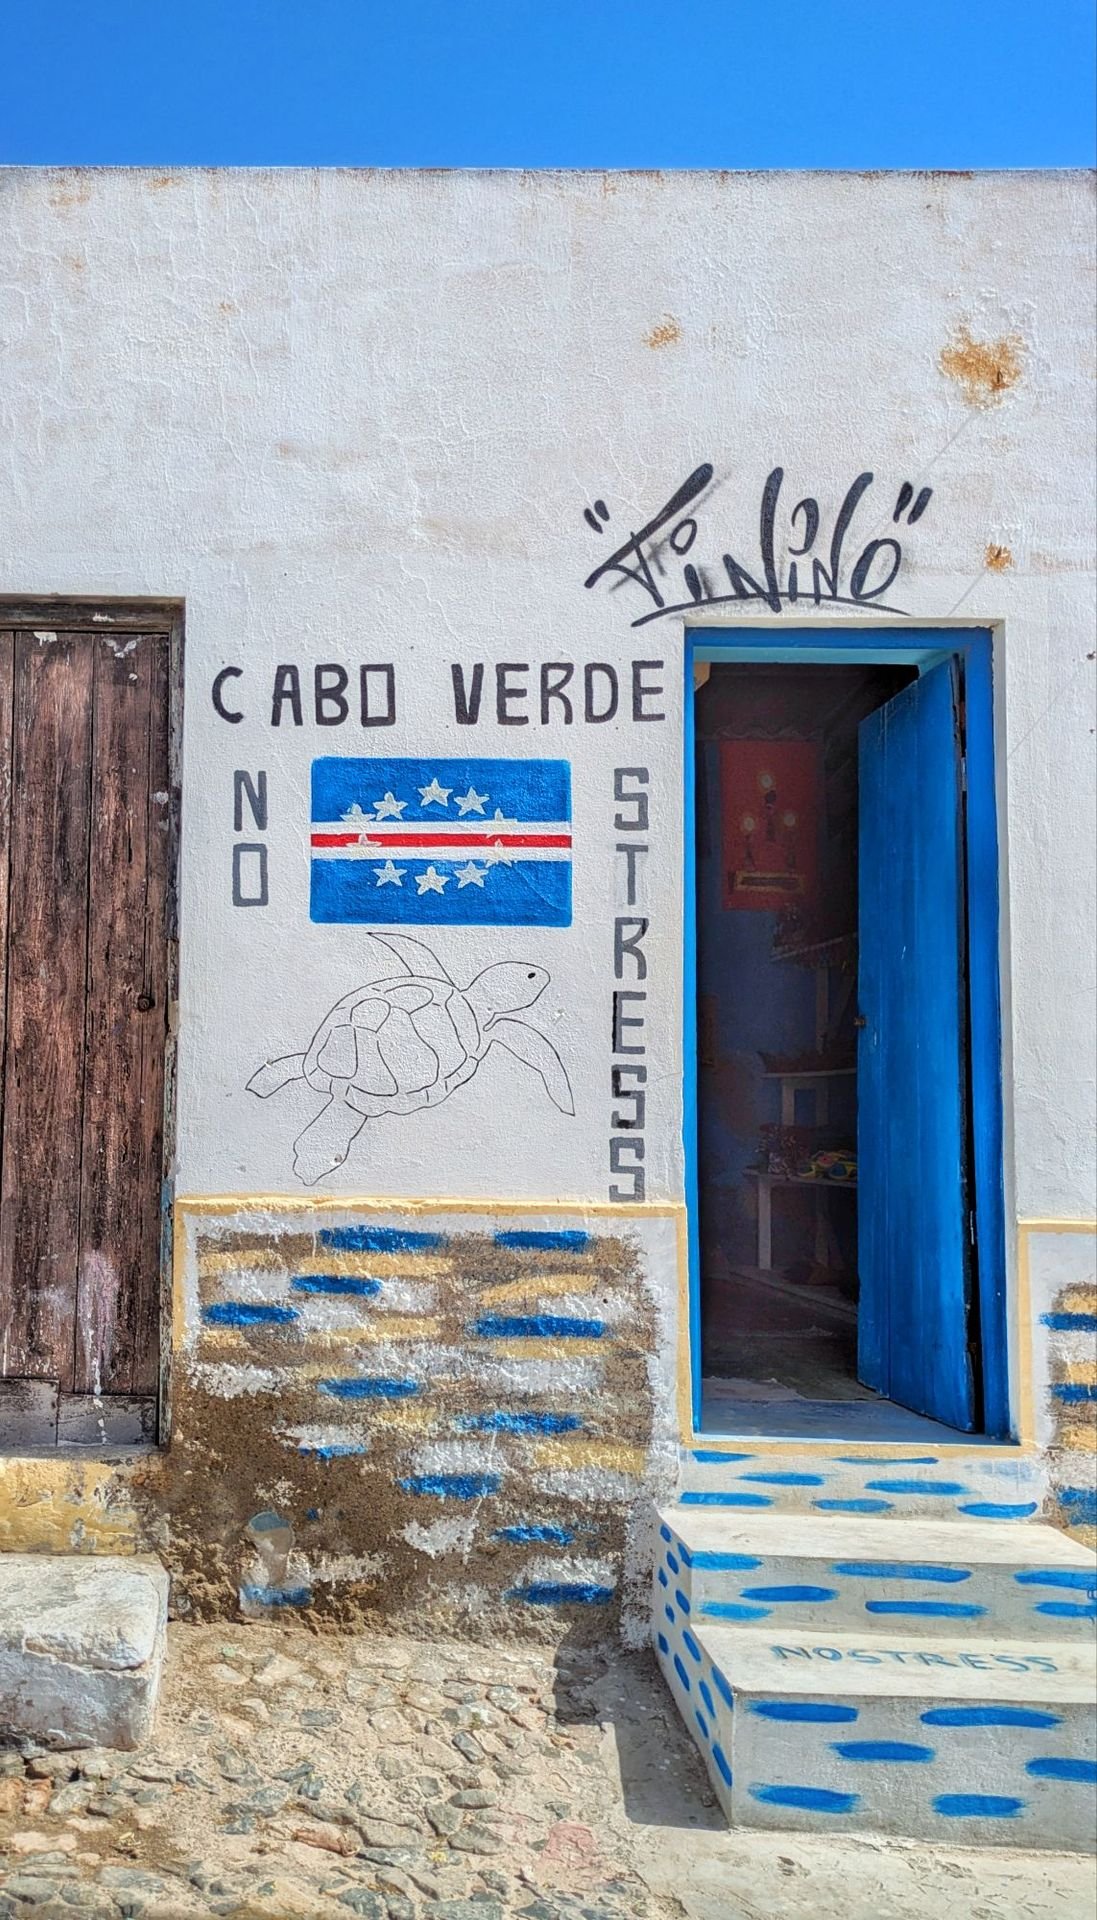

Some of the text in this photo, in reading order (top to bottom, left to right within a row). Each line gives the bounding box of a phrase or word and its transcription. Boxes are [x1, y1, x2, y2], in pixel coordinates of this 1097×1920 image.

[211, 660, 666, 727] CABO VERDE
[232, 769, 268, 906] NO
[609, 767, 650, 1203] STRESS
